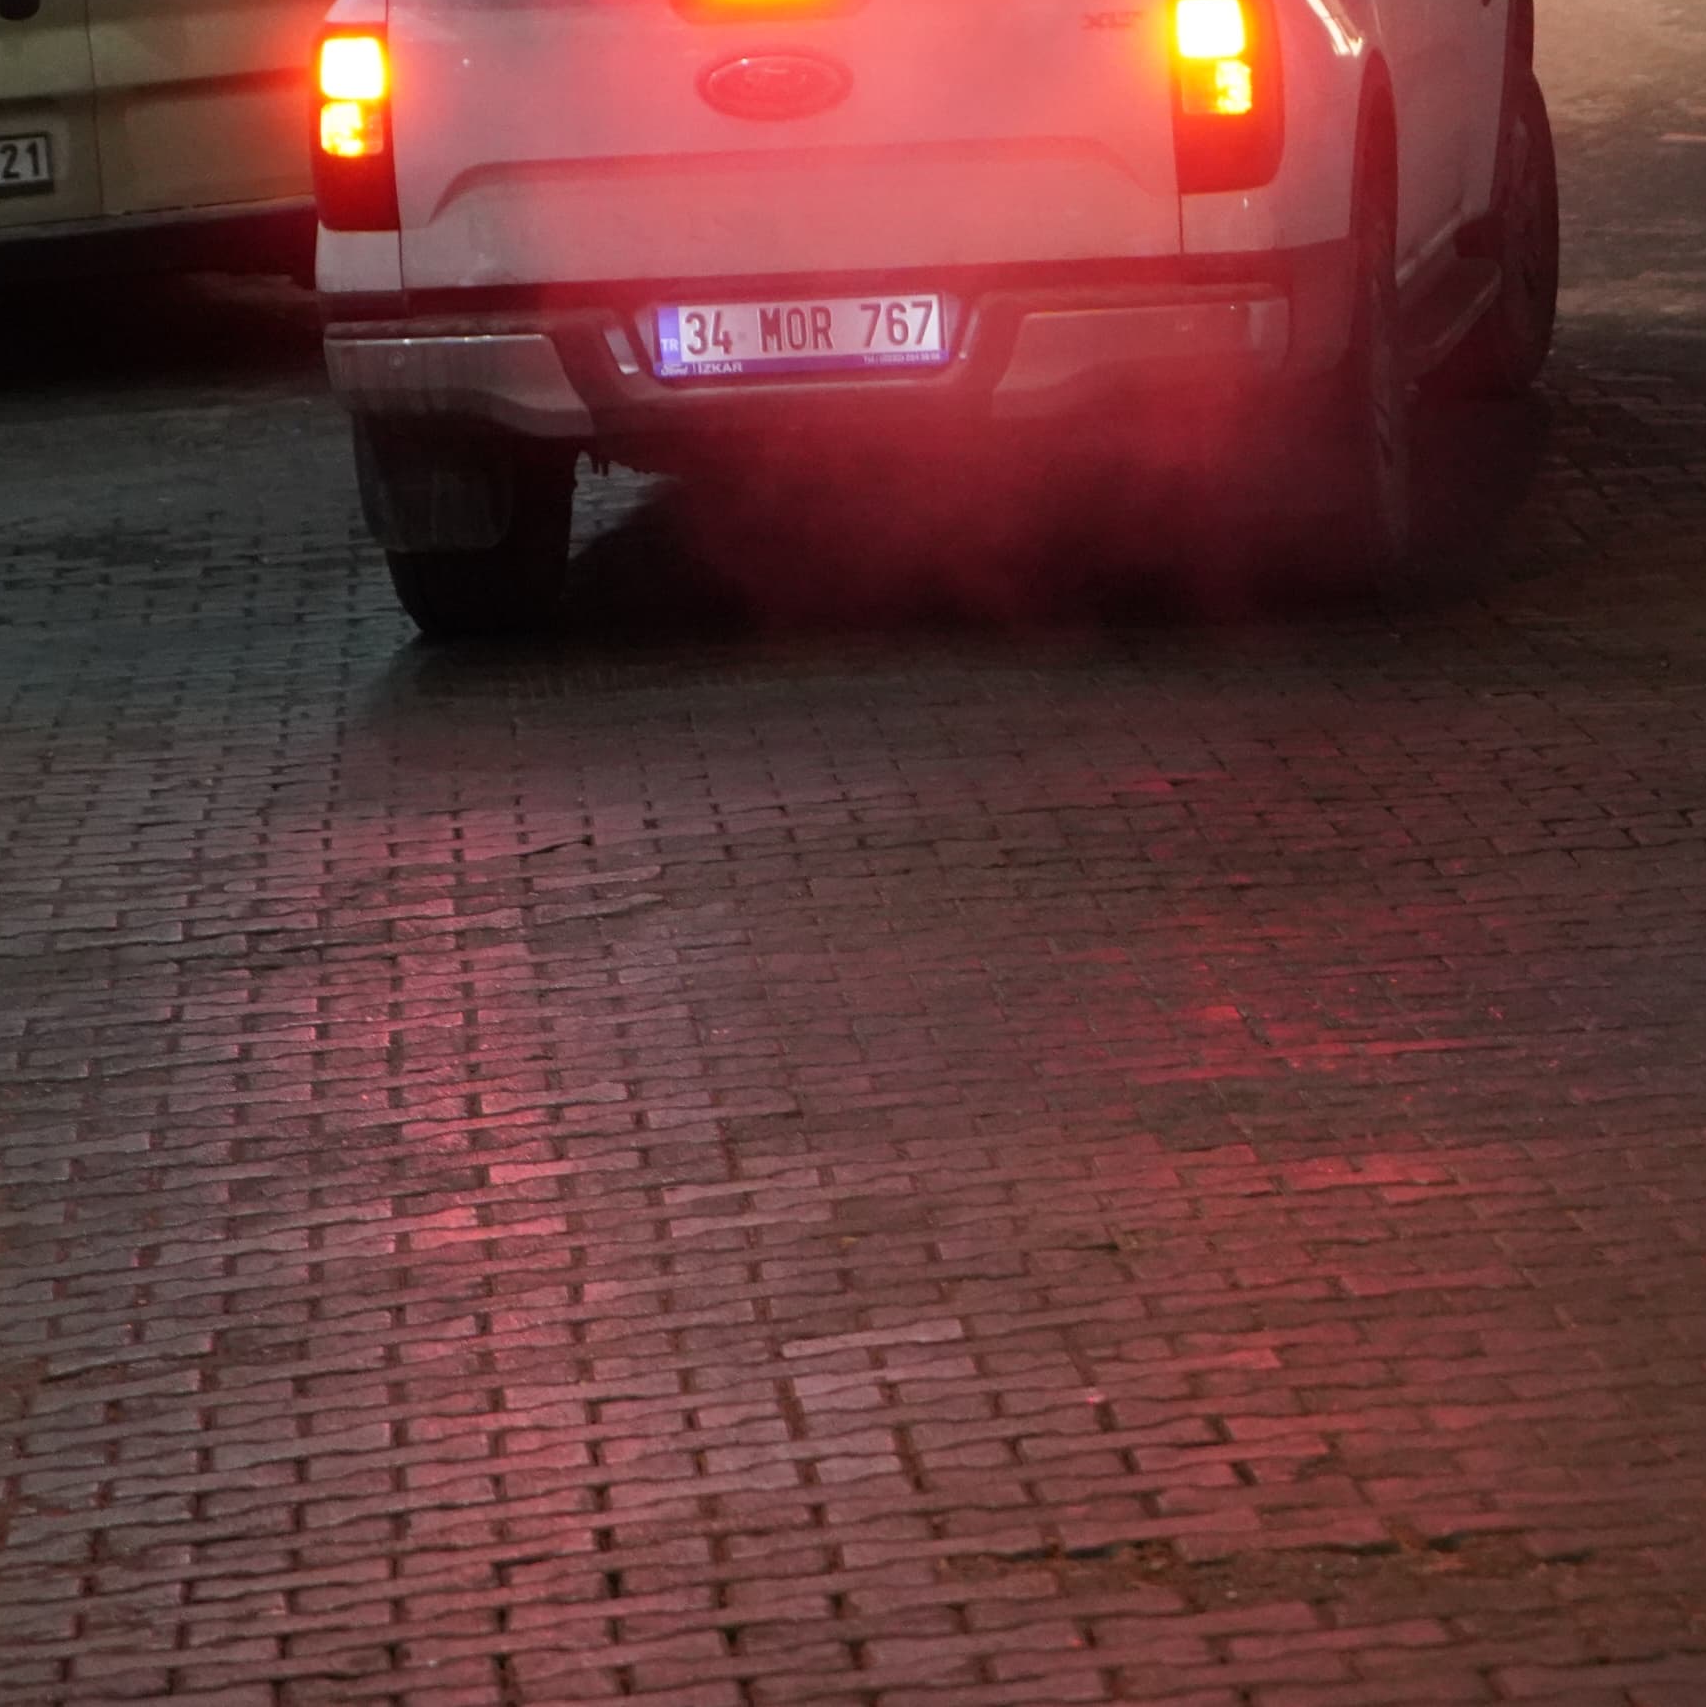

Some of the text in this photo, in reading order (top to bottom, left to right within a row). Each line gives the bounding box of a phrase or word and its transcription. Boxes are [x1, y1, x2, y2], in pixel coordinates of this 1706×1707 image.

[661, 338, 680, 352] TR
[684, 300, 933, 356] 34 MOR 767
